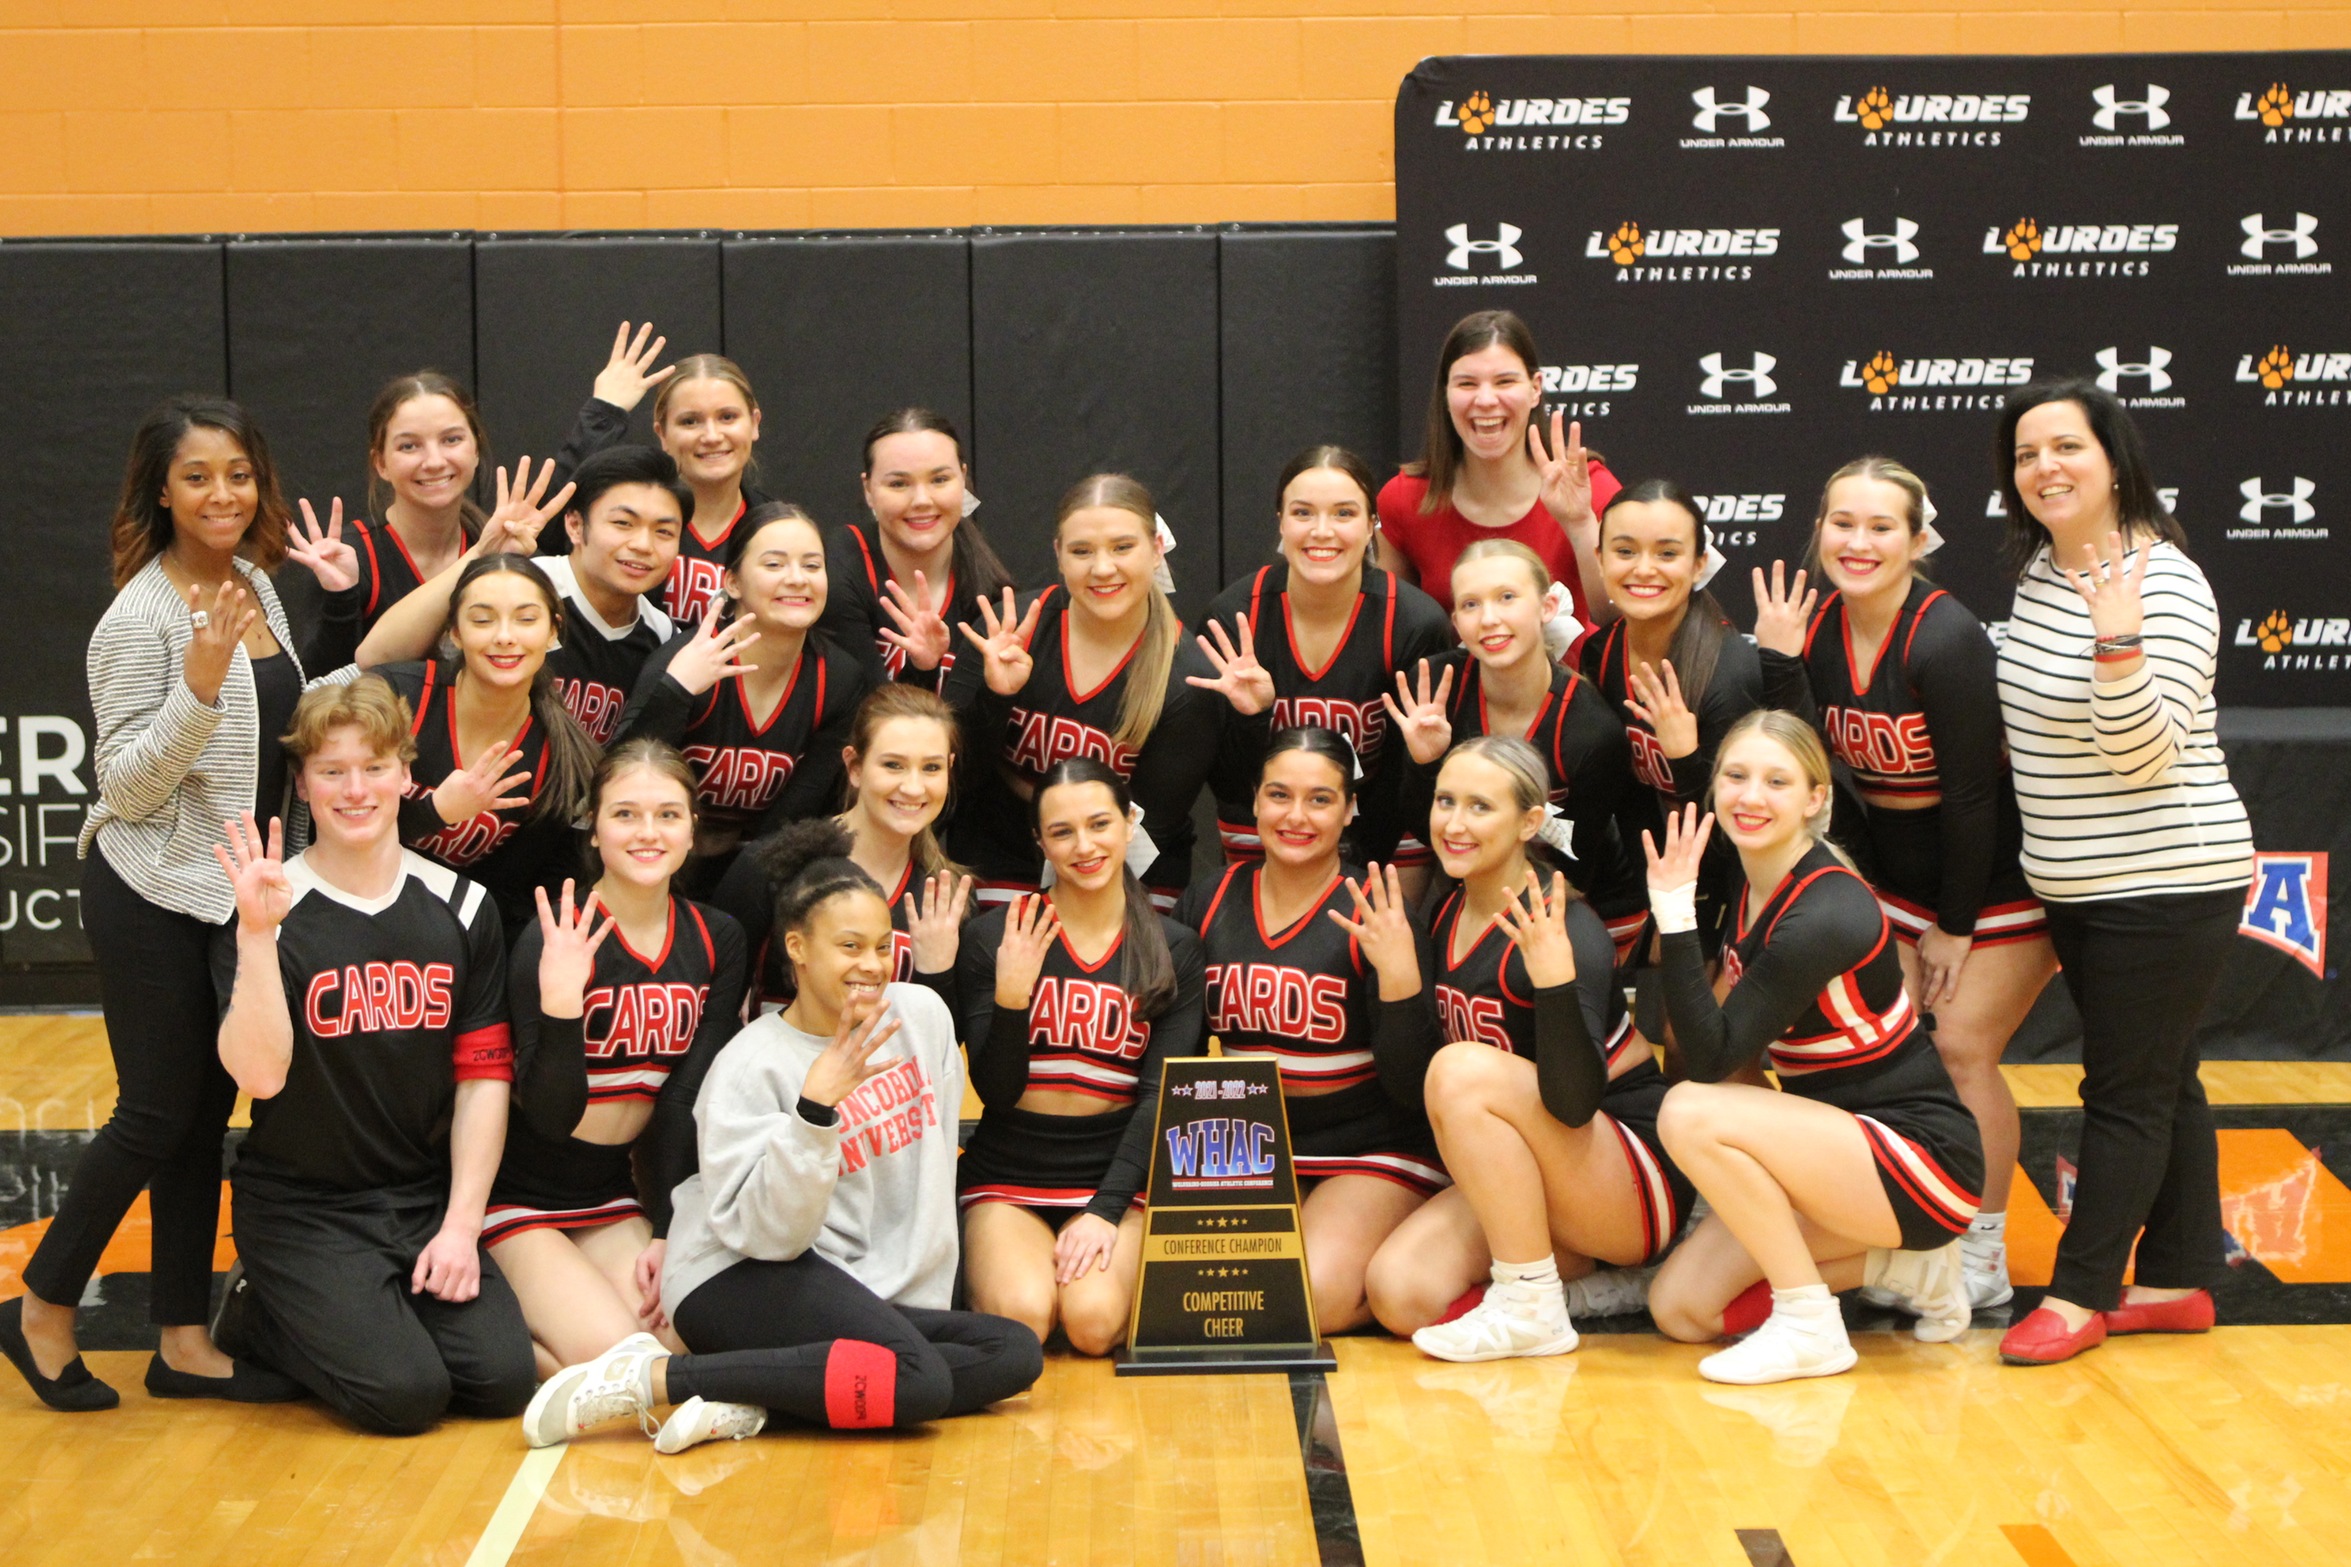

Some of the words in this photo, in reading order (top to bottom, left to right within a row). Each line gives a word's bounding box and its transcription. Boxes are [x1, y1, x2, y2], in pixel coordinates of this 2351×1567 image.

[2235, 83, 2351, 126] LOUR
[1466, 135, 1602, 150] ATHLETICS
[1680, 138, 1725, 148] UNDER
[1728, 138, 1784, 147] ARMOUR
[1865, 132, 2001, 146] ATHLETICS
[2080, 135, 2124, 145] UNDER
[2128, 135, 2184, 145] ARMOUR
[1617, 266, 1751, 281] ATHLETICS
[1829, 269, 1873, 279] UNDER
[1877, 269, 1933, 278] ARMOUR
[2014, 262, 2149, 276] ATHLETICS
[2227, 264, 2271, 274] UNDER
[2275, 263, 2331, 273] ARMOUR
[1434, 276, 1478, 286] UNDER
[1481, 275, 1537, 284] ARMOUR
[2236, 345, 2351, 389] LOUR
[1688, 404, 1731, 414] UNDER
[1735, 403, 1790, 413] ARMOUR
[1871, 395, 2004, 410] ATHLETICS
[2130, 398, 2185, 407] ARMOUR
[2227, 529, 2270, 538] UNDER
[2274, 529, 2328, 538] ARMOUR
[2235, 610, 2351, 652] LOUR
[1824, 706, 1937, 774] ARDS
[305, 960, 453, 1038] CARDS
[1028, 976, 1151, 1060] ARDS
[1194, 1080, 1245, 1100] 2021-2022
[1166, 1118, 1275, 1177] WHAC
[1164, 1239, 1226, 1255] CONFERENCE
[1230, 1238, 1281, 1253] CHAMPION
[1183, 1291, 1264, 1312] COMPETITIVE
[1204, 1318, 1243, 1337] CHEER
